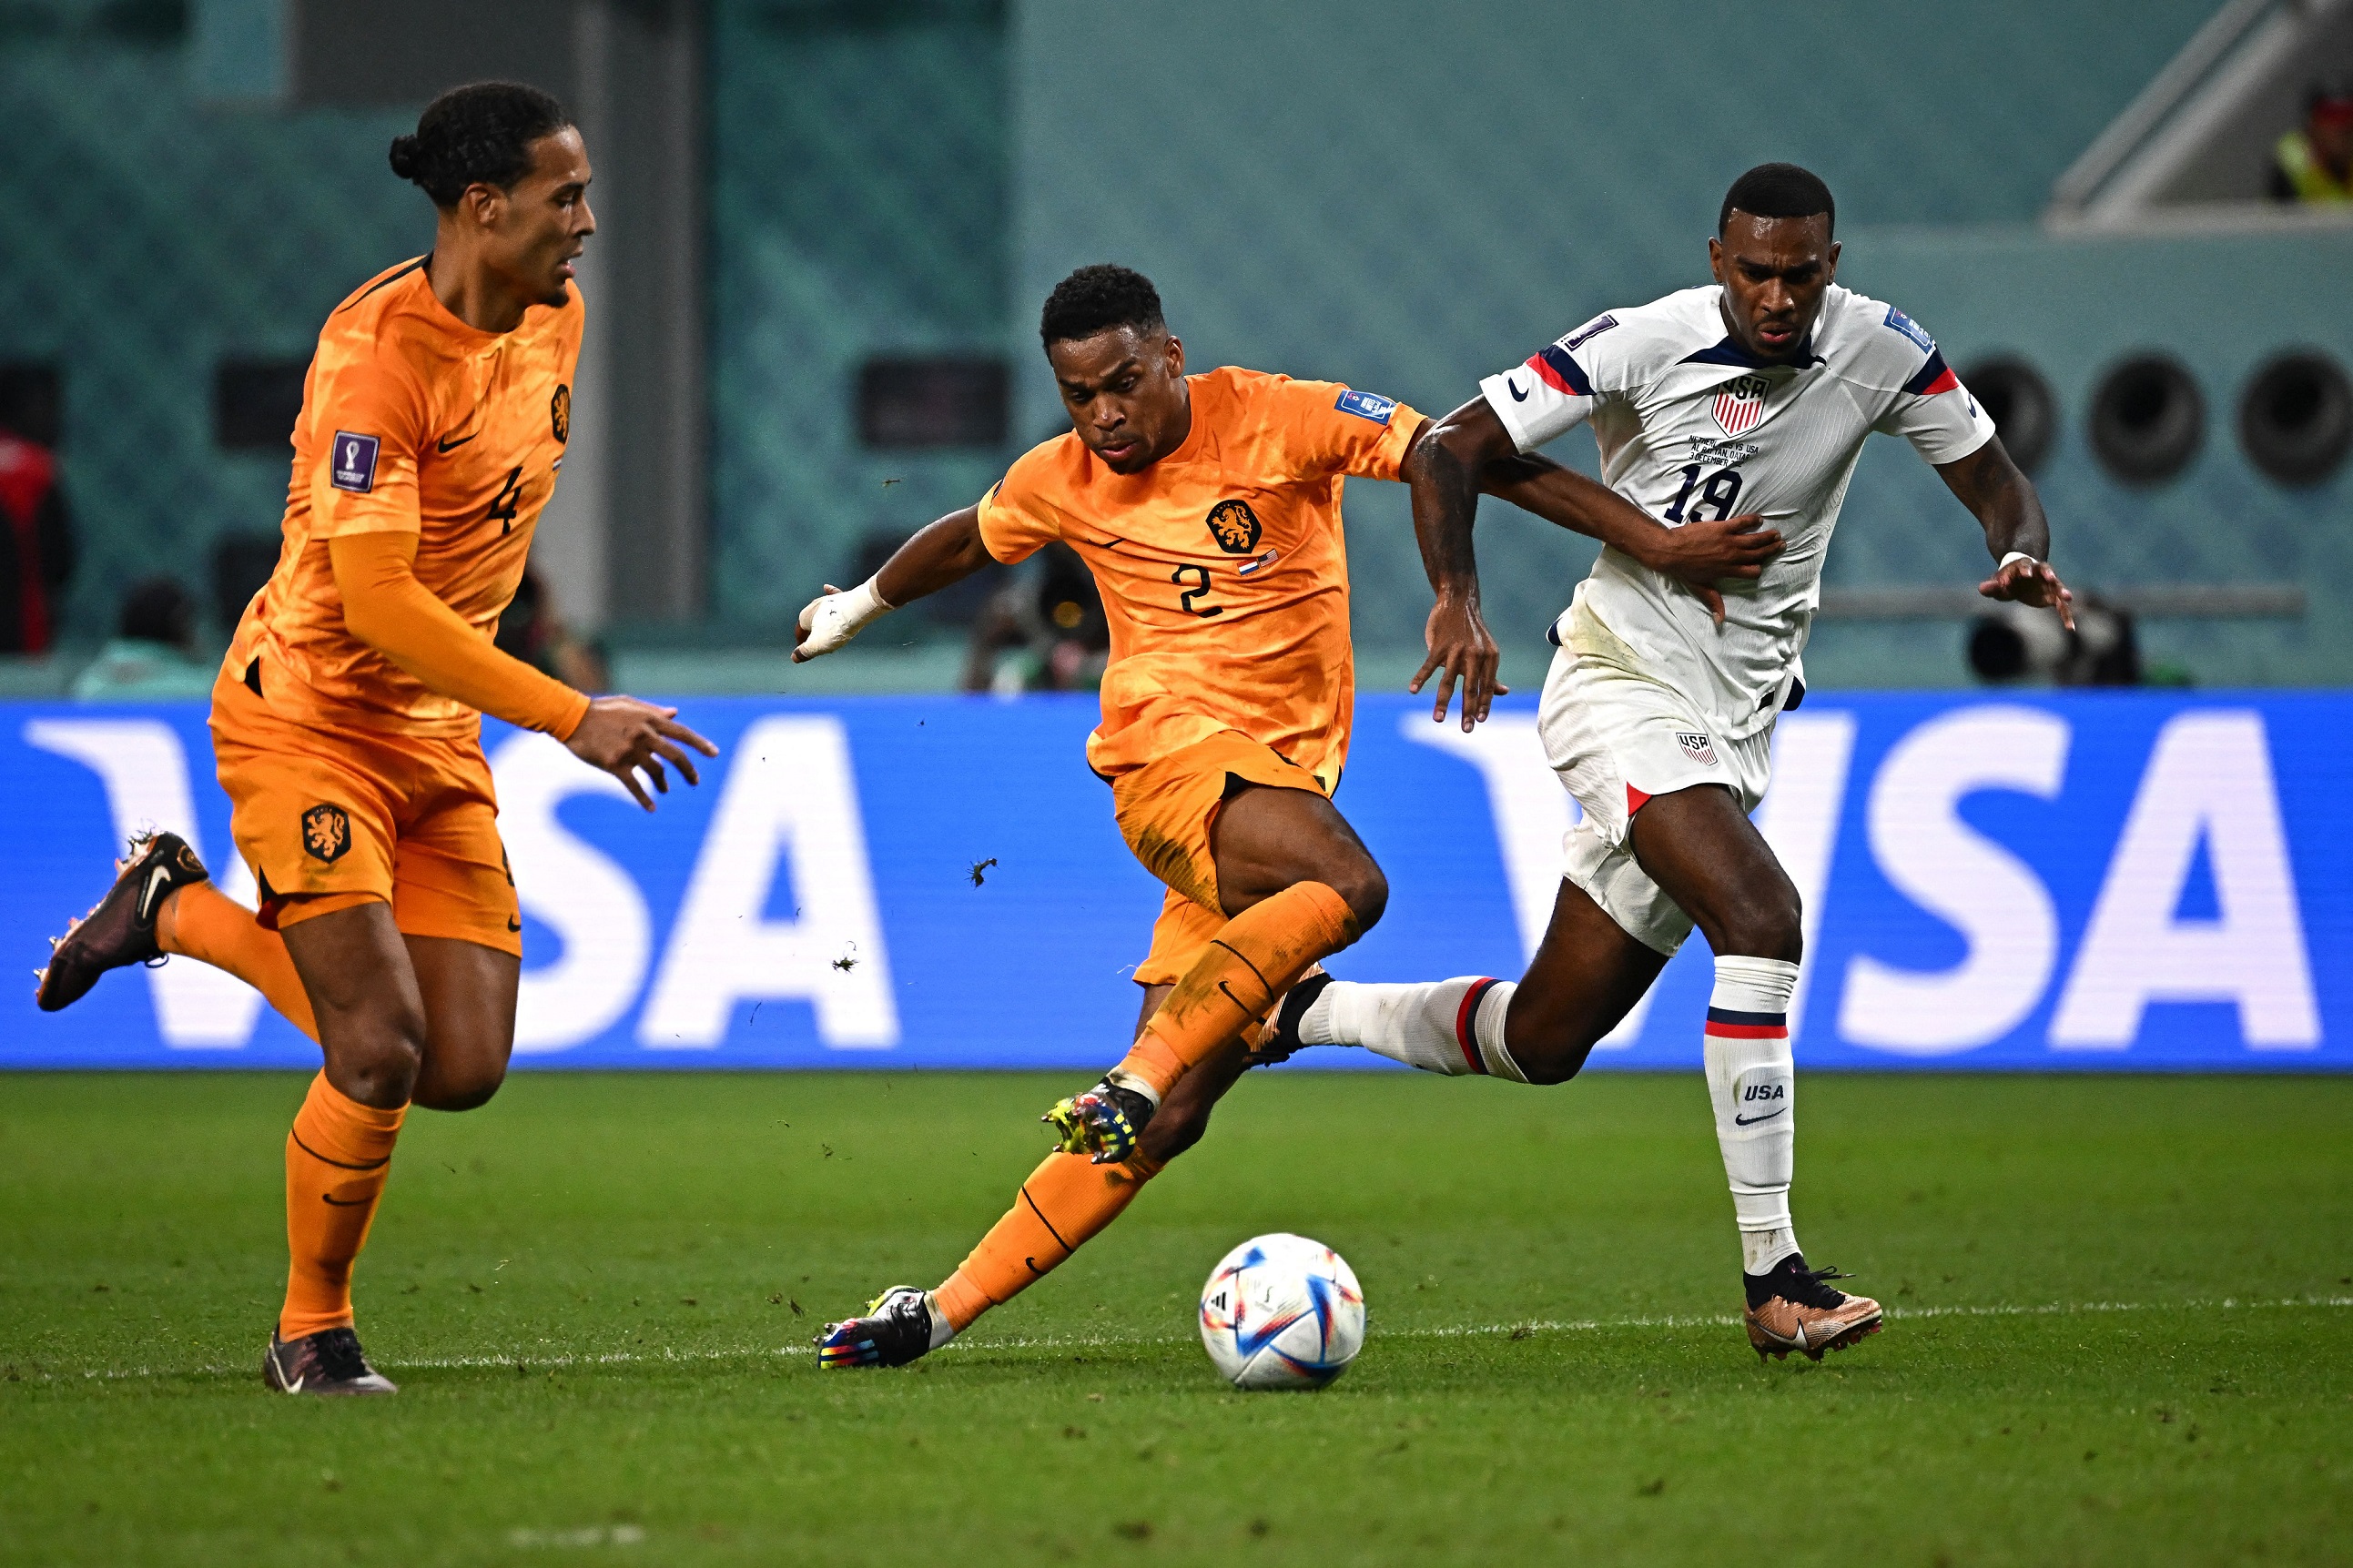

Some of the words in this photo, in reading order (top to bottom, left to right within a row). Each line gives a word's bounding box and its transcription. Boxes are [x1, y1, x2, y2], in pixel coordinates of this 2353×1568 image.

[1691, 443, 1699, 452] AL
[1735, 443, 1744, 451] VS
[1746, 444, 1759, 454] USA
[1689, 452, 1694, 460] 3
[1695, 454, 1729, 467] DECEMBER
[487, 466, 523, 535] 4
[1663, 463, 1743, 524] 19
[1171, 562, 1224, 619] 2
[1679, 734, 1709, 751] USA
[1744, 1085, 1784, 1101] USA
